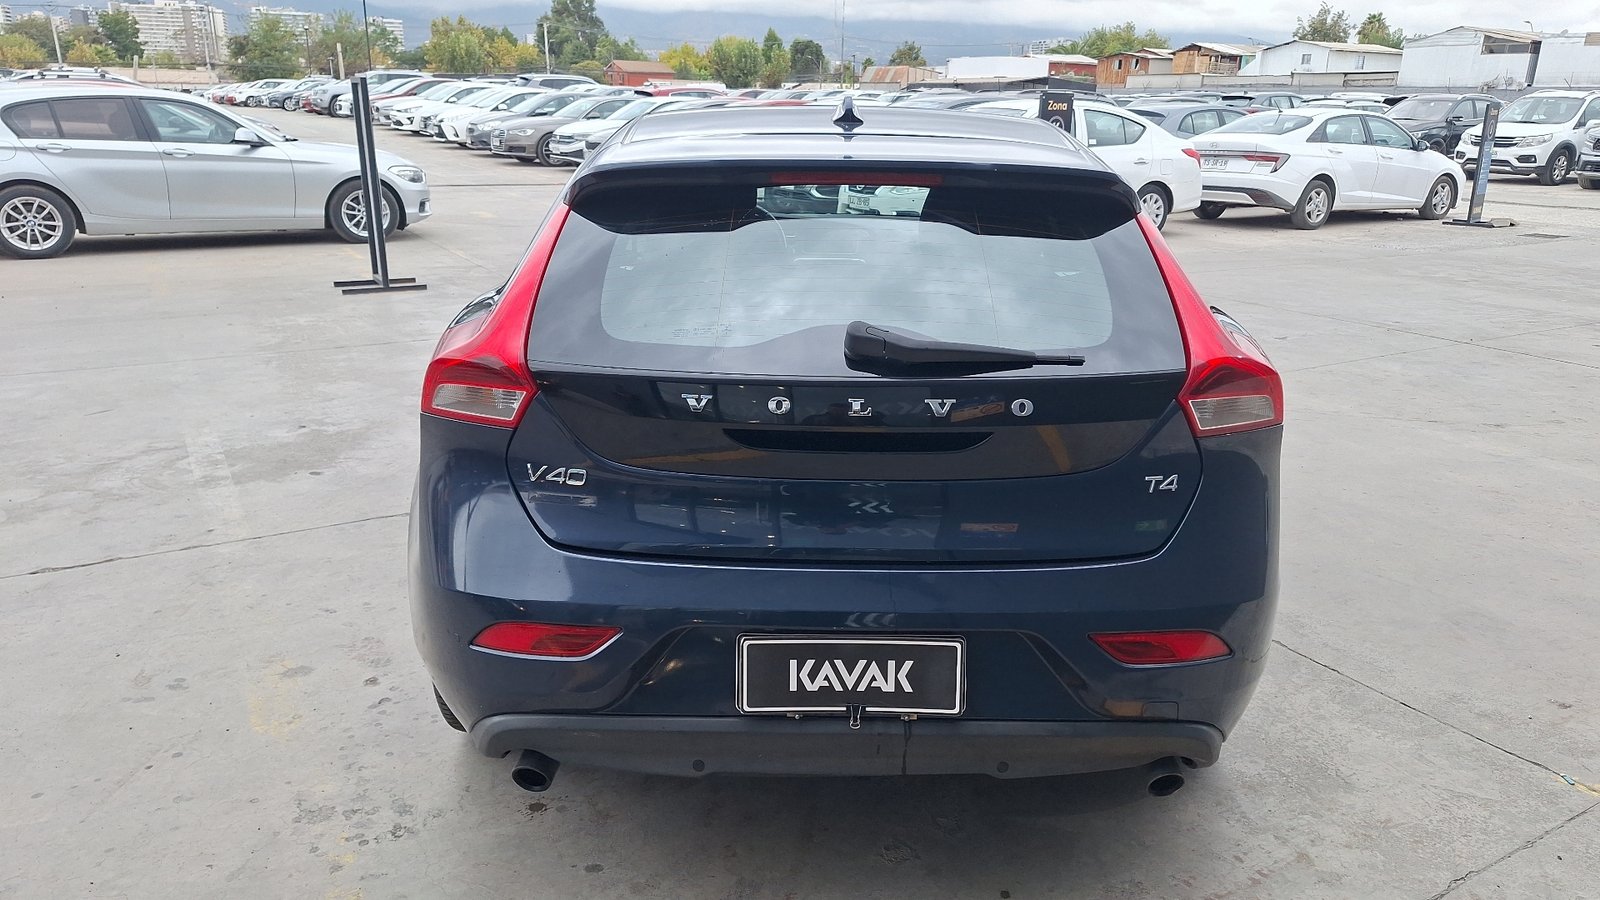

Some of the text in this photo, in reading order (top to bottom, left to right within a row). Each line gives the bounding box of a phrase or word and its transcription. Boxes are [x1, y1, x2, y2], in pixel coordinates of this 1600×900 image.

[1047, 100, 1068, 111] Zona
[681, 394, 1034, 417] VOLVO
[526, 463, 587, 486] V40
[1145, 474, 1178, 493] T4
[789, 659, 914, 692] KAVAK
